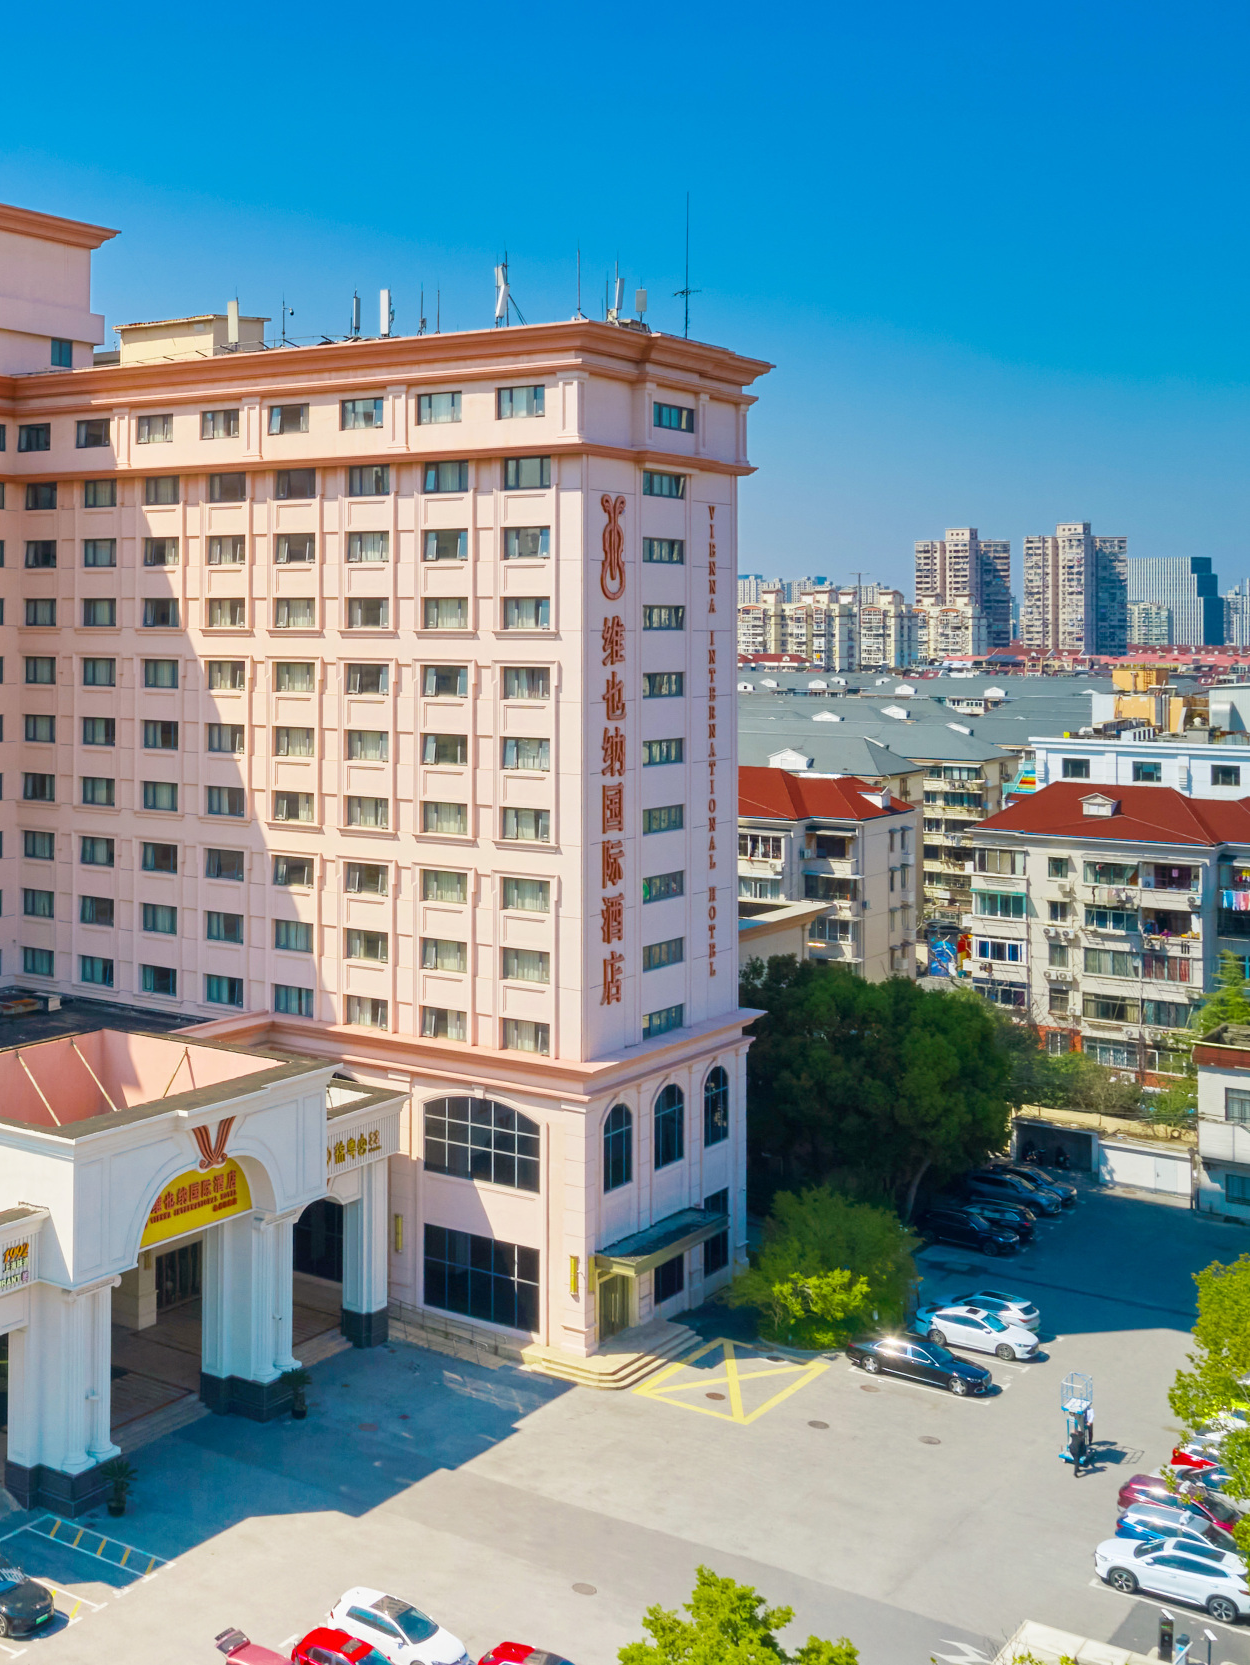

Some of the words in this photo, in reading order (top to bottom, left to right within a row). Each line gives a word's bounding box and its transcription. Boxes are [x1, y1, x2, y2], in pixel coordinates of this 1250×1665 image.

[708, 505, 717, 614] VIENNA
[707, 630, 717, 870] INTERNATIONAL
[599, 615, 627, 1006] 维也纳国际酒店
[708, 886, 717, 977] HOTEL
[3, 1242, 30, 1263] 1992
